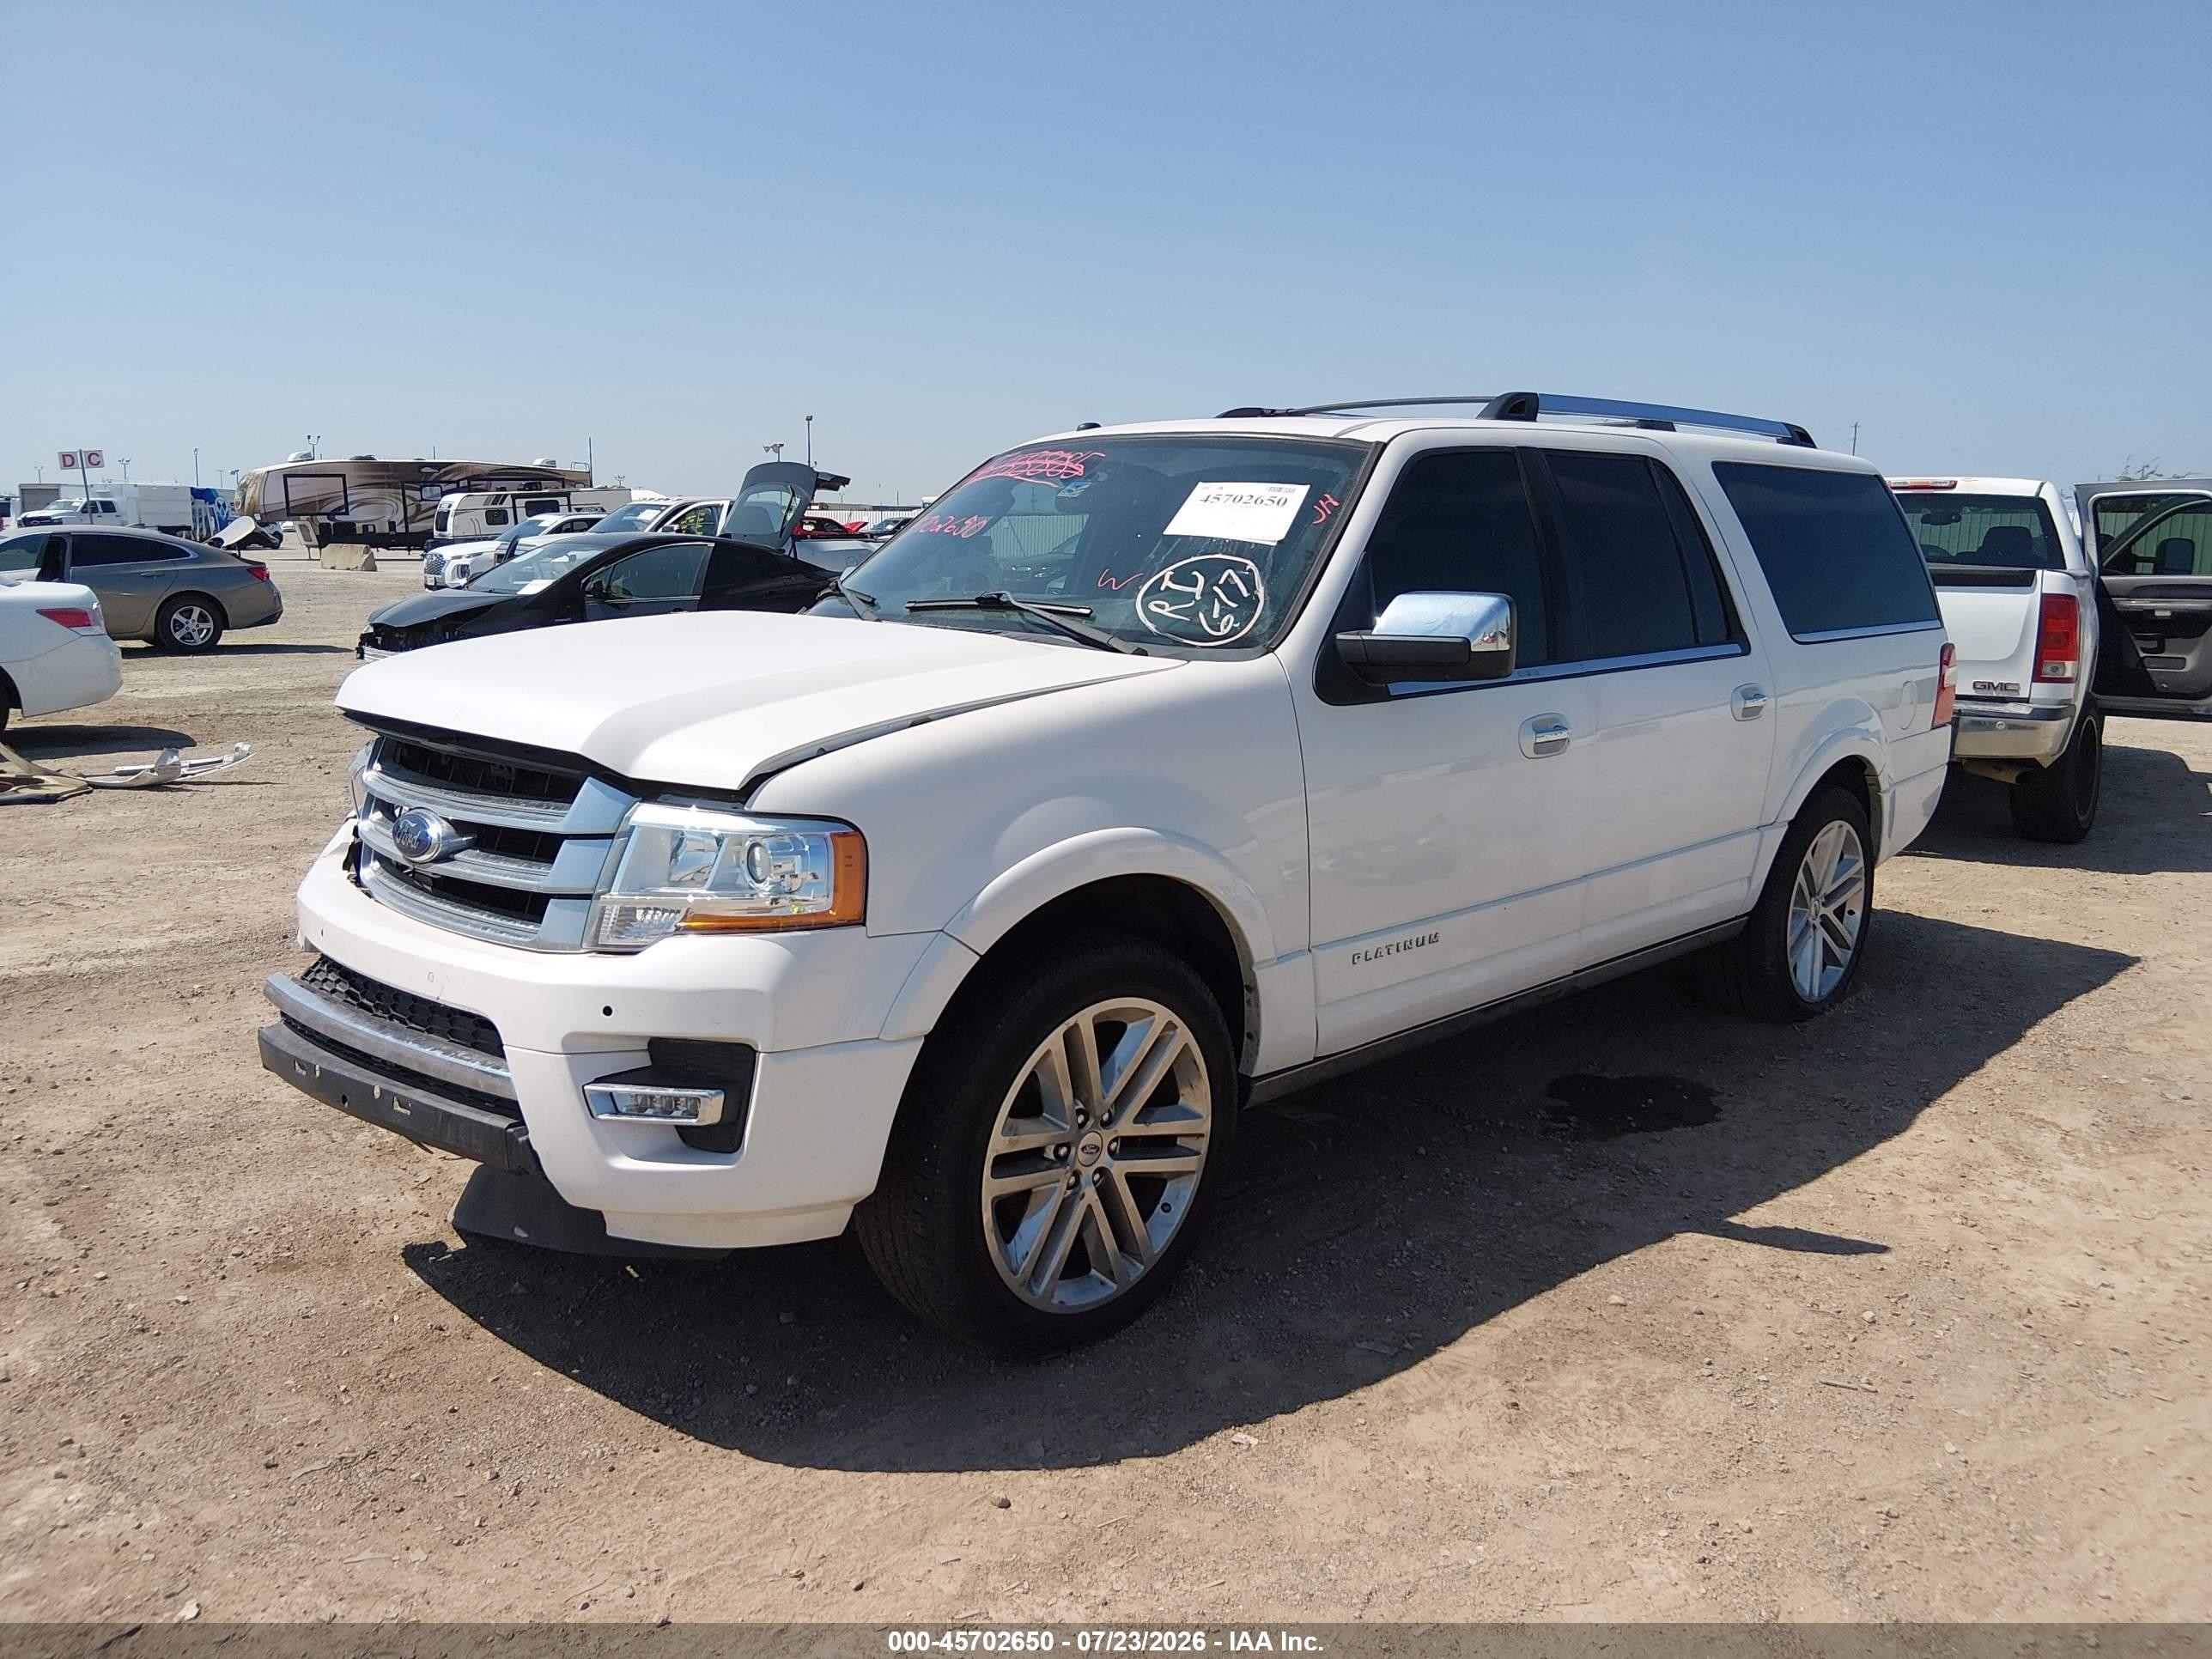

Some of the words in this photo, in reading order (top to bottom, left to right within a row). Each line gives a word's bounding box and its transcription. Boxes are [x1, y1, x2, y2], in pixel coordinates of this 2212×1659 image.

[61, 453, 76, 468] D
[87, 452, 101, 466] C
[1200, 494, 1288, 507] 45702650
[1972, 680, 2021, 692] GMC
[396, 818, 422, 849] Ford
[1352, 932, 1440, 965] PLATINUM
